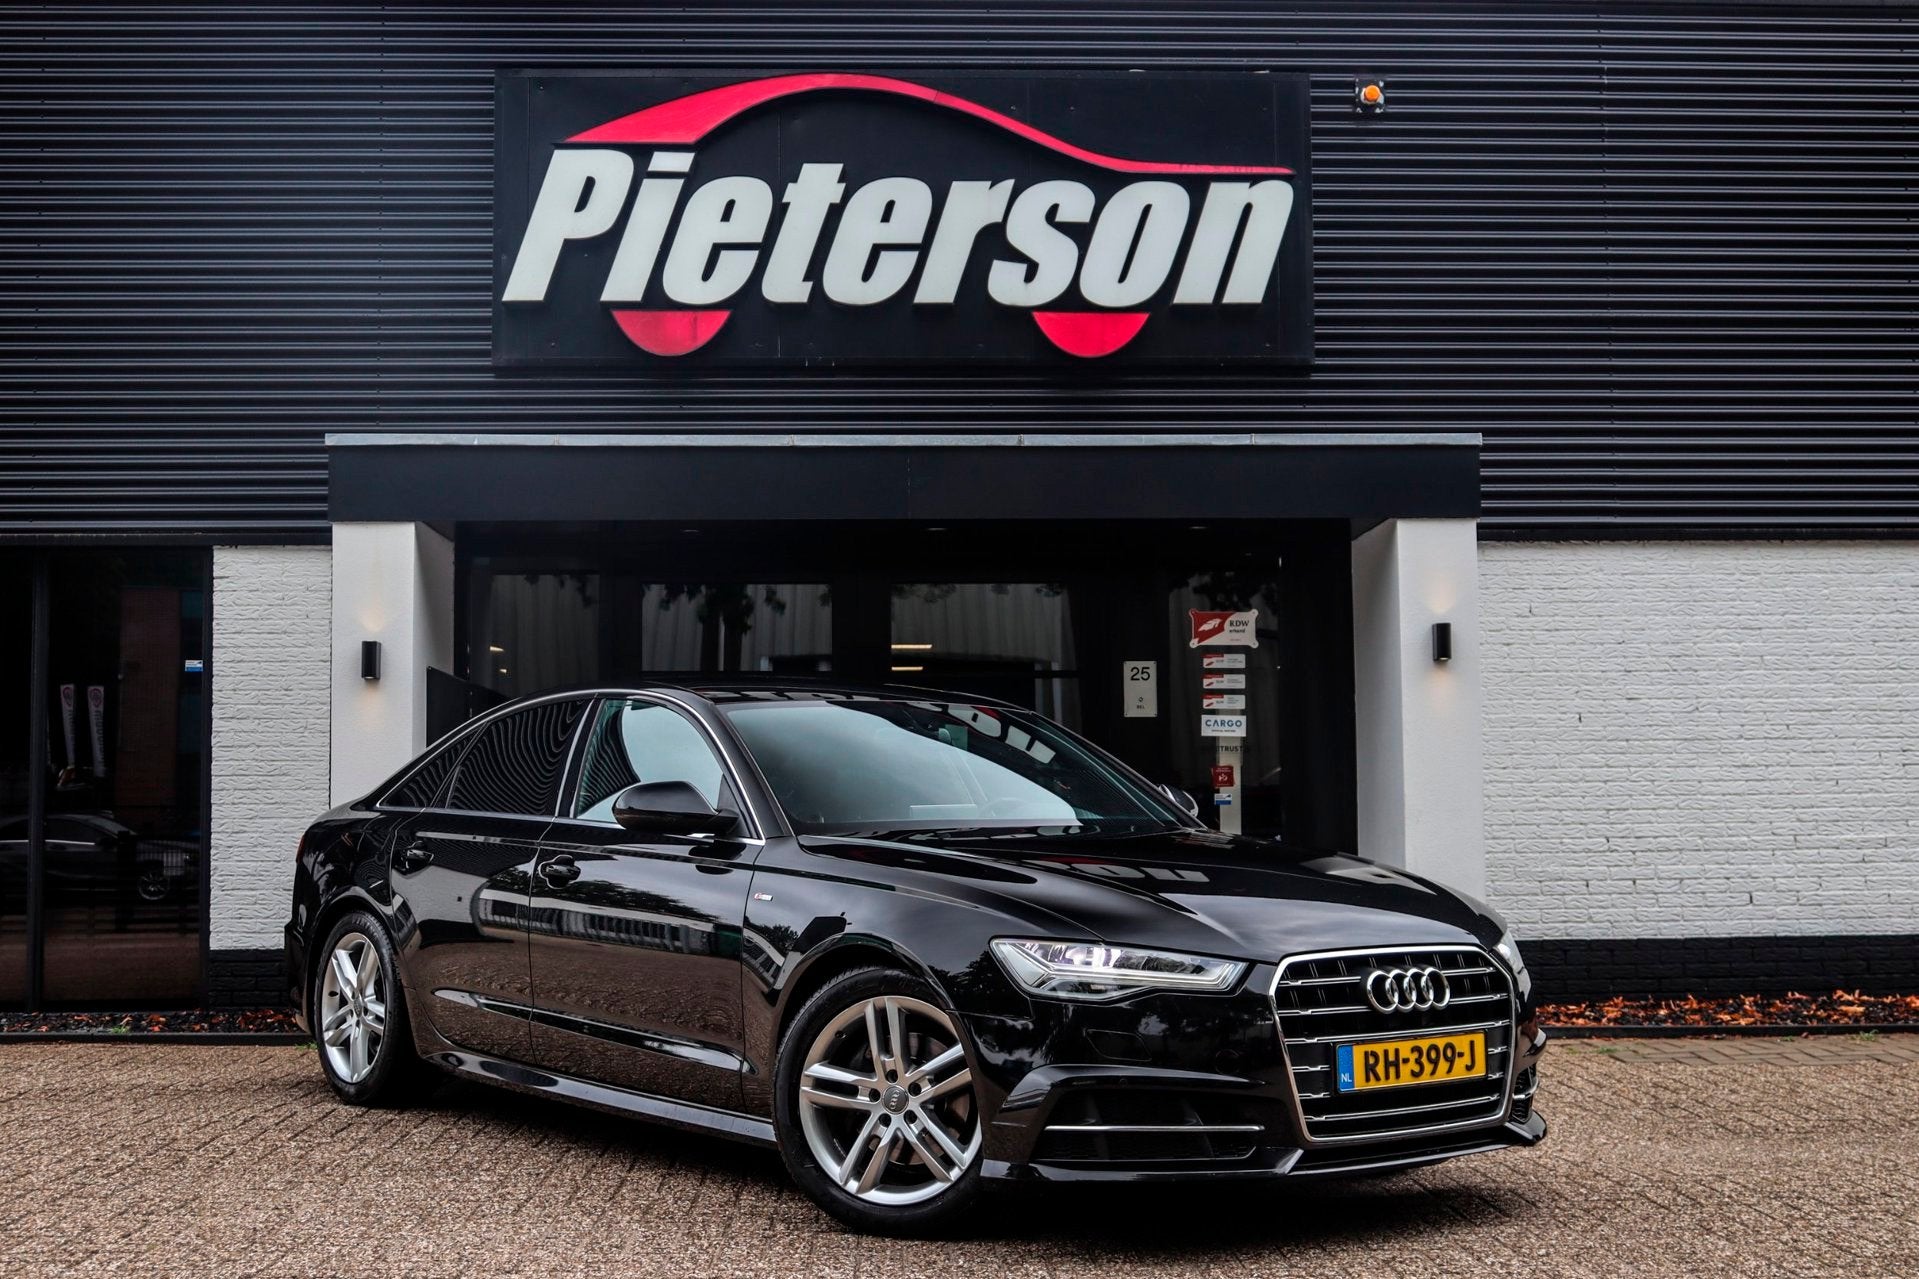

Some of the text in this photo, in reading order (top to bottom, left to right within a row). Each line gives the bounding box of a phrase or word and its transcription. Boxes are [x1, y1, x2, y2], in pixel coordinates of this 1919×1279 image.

[502, 147, 1295, 307] Pieterson
[1130, 666, 1150, 681] 25
[1205, 719, 1243, 727] CARGO
[1341, 1040, 1476, 1083] NL RH-399-J
